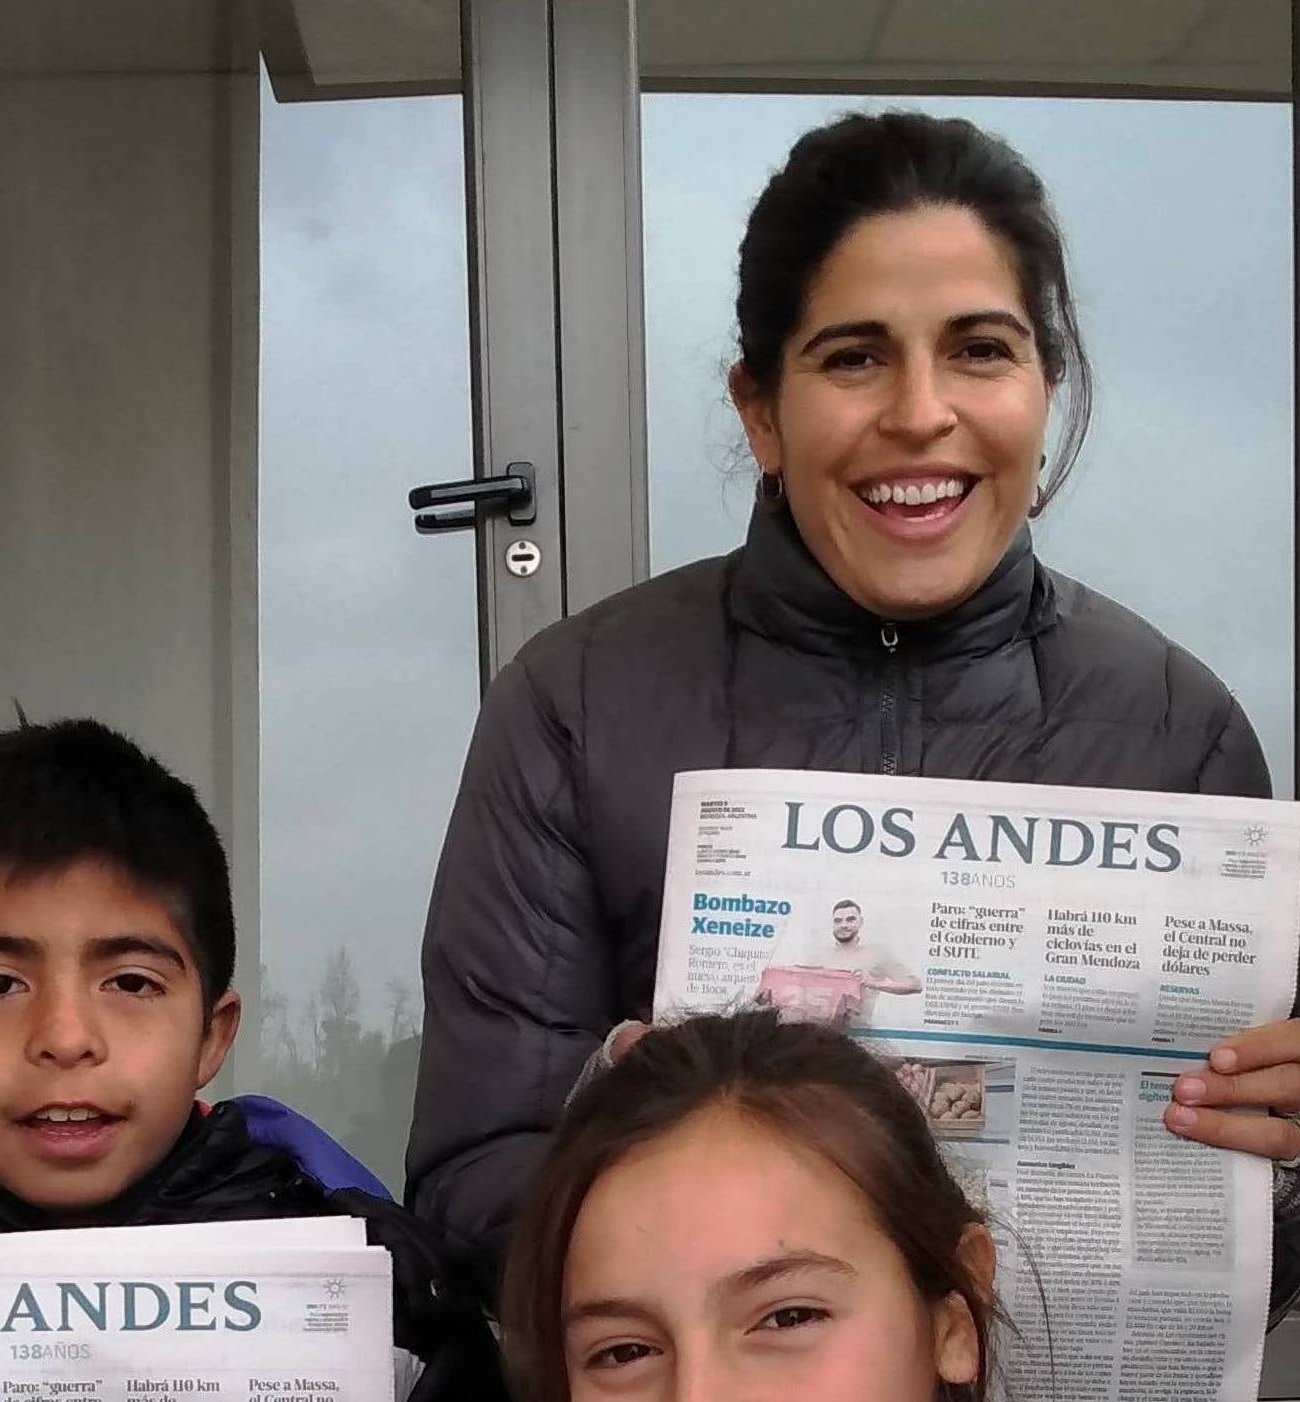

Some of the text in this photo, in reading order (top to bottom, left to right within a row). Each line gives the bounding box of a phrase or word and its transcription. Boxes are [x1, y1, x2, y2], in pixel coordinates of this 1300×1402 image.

[781, 801, 916, 857] LOS
[932, 812, 1183, 873] ANDES
[693, 893, 791, 916] Bombazo
[931, 902, 966, 916] Paro:
[931, 917, 1024, 933] de cifras entre
[1048, 908, 1137, 926] Habrá 110 km
[1164, 915, 1196, 930] Pese
[1198, 920, 1206, 931] a
[691, 917, 775, 938] Xeneize
[1047, 924, 1094, 937] más de
[929, 931, 1017, 949] el Gobierno y
[1046, 938, 1137, 955] ciclovías en el
[1163, 931, 1247, 948] el Central no
[928, 946, 980, 960] el SUTE
[1045, 953, 1141, 970] Gran Mendoza
[1162, 946, 1257, 966] deja de perder
[1161, 959, 1211, 976] dólares
[0, 1280, 263, 1334] ANDES
[2, 1380, 39, 1394] Paro:
[126, 1378, 220, 1392] Habrá 110 km
[249, 1379, 340, 1394] Pese a Massa,
